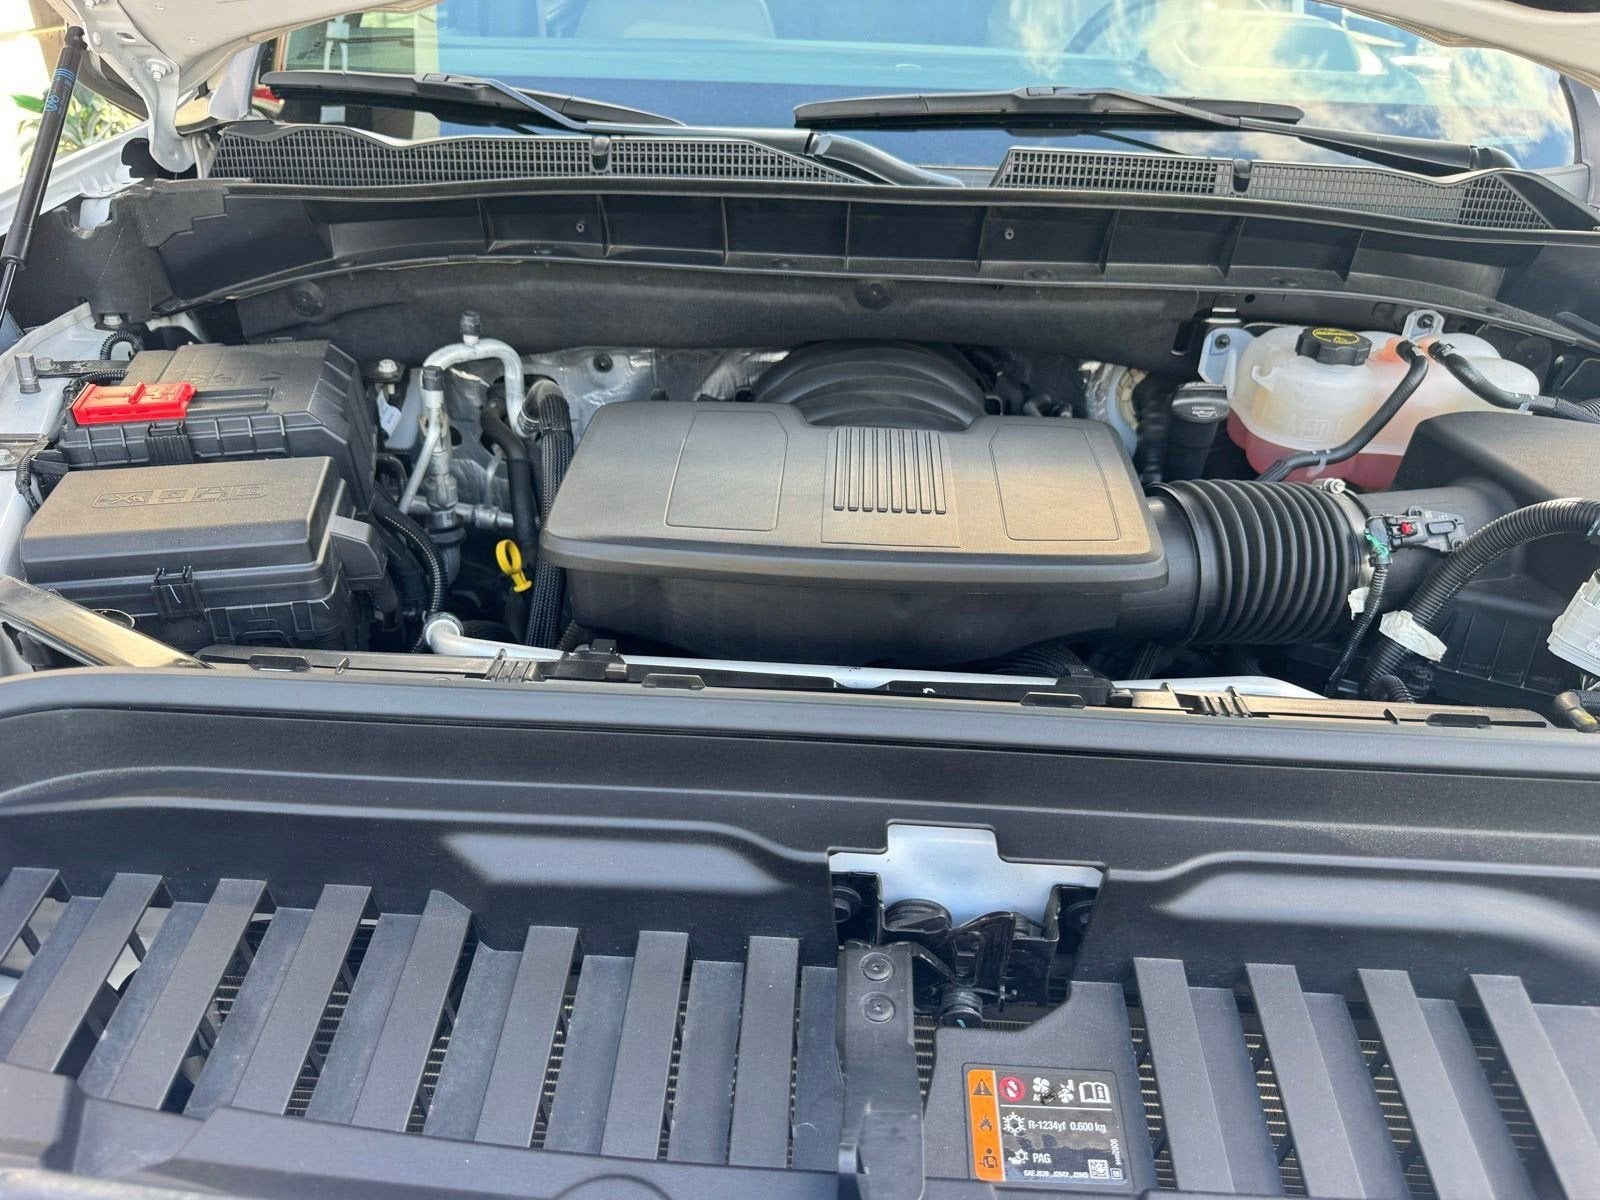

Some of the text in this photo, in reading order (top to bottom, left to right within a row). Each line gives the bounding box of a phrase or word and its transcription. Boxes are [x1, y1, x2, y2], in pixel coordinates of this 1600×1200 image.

[1027, 1120, 1106, 1133] R-1234yf 0.600 kg
[1032, 1152, 1052, 1164] PAG
